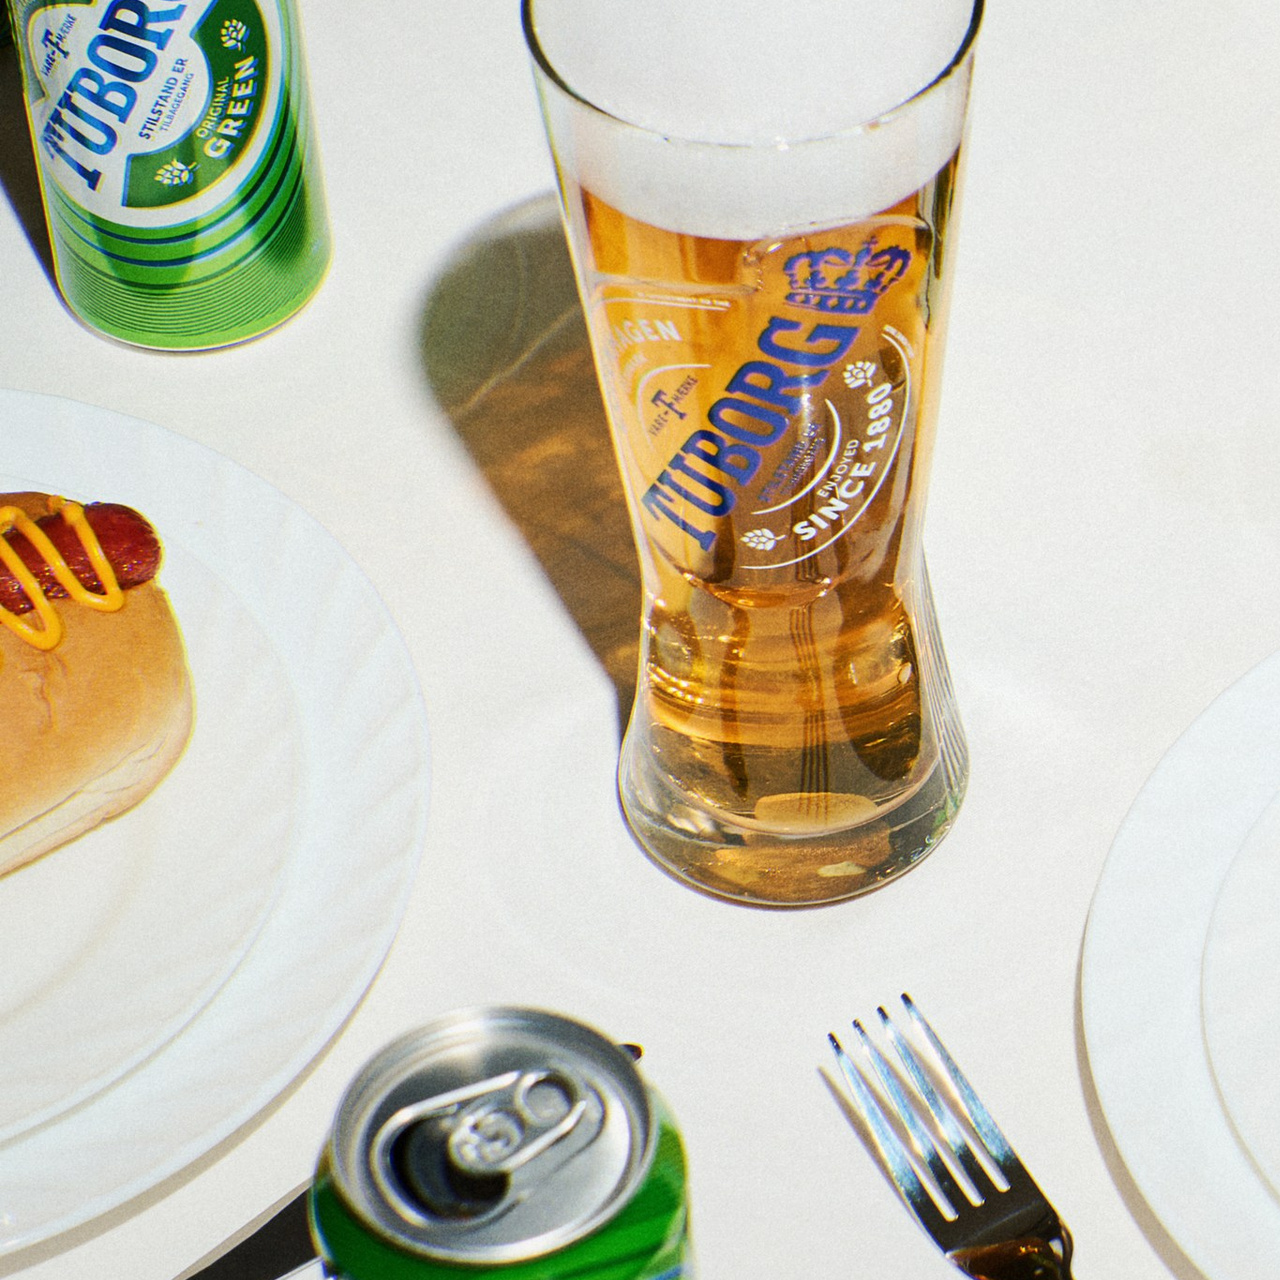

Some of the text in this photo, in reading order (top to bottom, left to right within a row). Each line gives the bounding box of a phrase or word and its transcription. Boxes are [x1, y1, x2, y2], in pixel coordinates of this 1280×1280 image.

[138, 57, 189, 141] STILSTAND ER
[159, 71, 196, 133] TILBAGEGANG
[195, 75, 231, 139] ORIGINAL
[203, 54, 259, 161] GREEN
[641, 315, 862, 553] TUBORG
[792, 458, 877, 542] SINCE
[862, 380, 893, 453] 1880
[816, 437, 861, 499] ENJOYED
